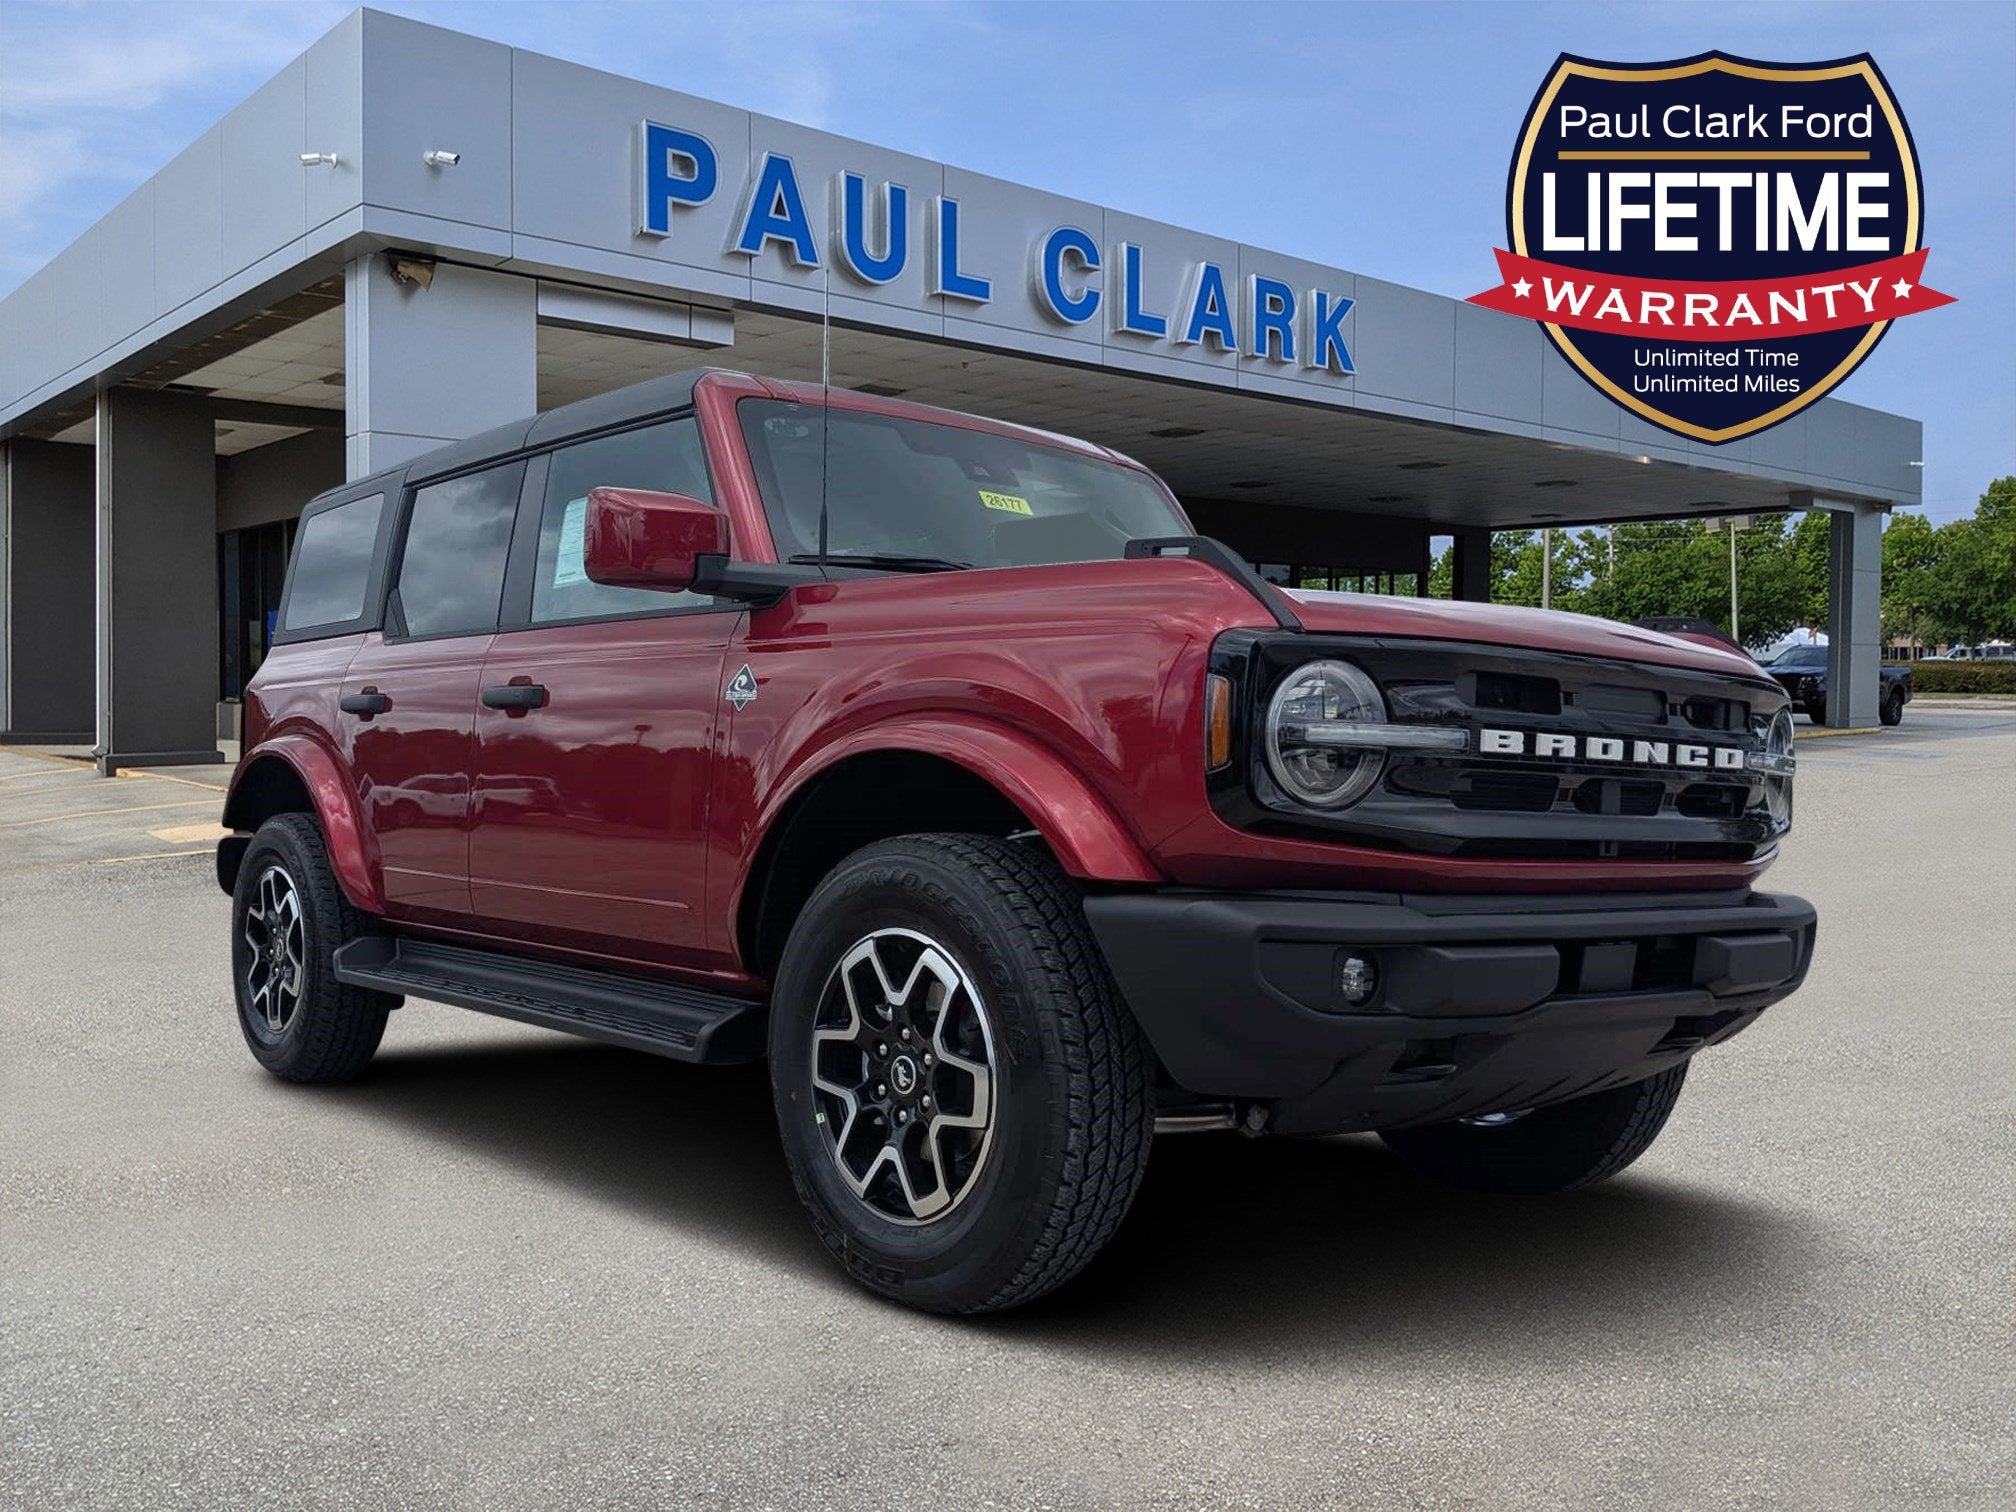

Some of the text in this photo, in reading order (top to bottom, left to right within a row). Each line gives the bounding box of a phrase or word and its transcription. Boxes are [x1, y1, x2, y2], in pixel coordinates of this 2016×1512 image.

[642, 118, 1357, 376] PAUL CLARK
[1480, 728, 1744, 769] BRONCO
